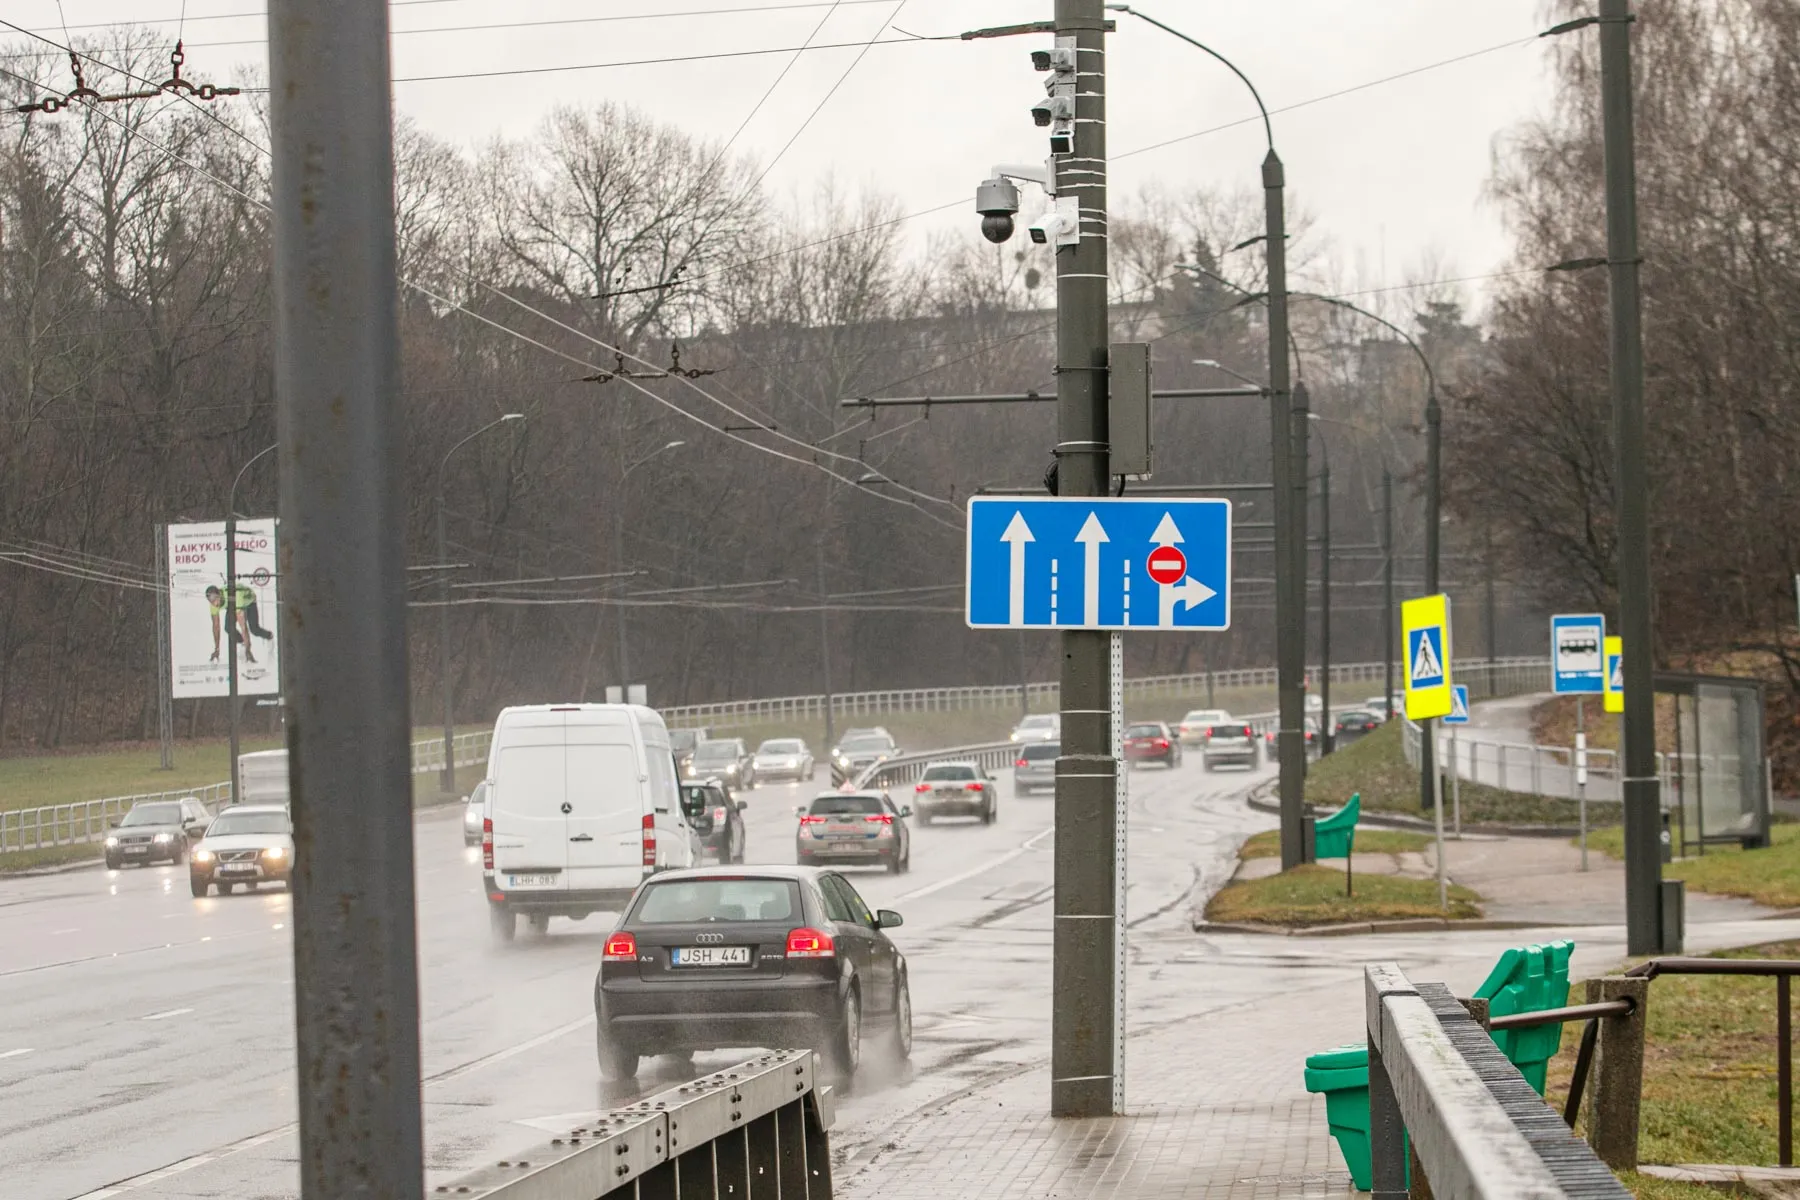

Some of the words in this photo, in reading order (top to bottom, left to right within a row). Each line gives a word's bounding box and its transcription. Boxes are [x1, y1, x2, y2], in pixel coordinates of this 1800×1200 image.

[175, 543, 222, 553] LAIKYKIS
[175, 554, 206, 564] RIBOS
[682, 949, 711, 963] JSH
[721, 949, 746, 962] 441
